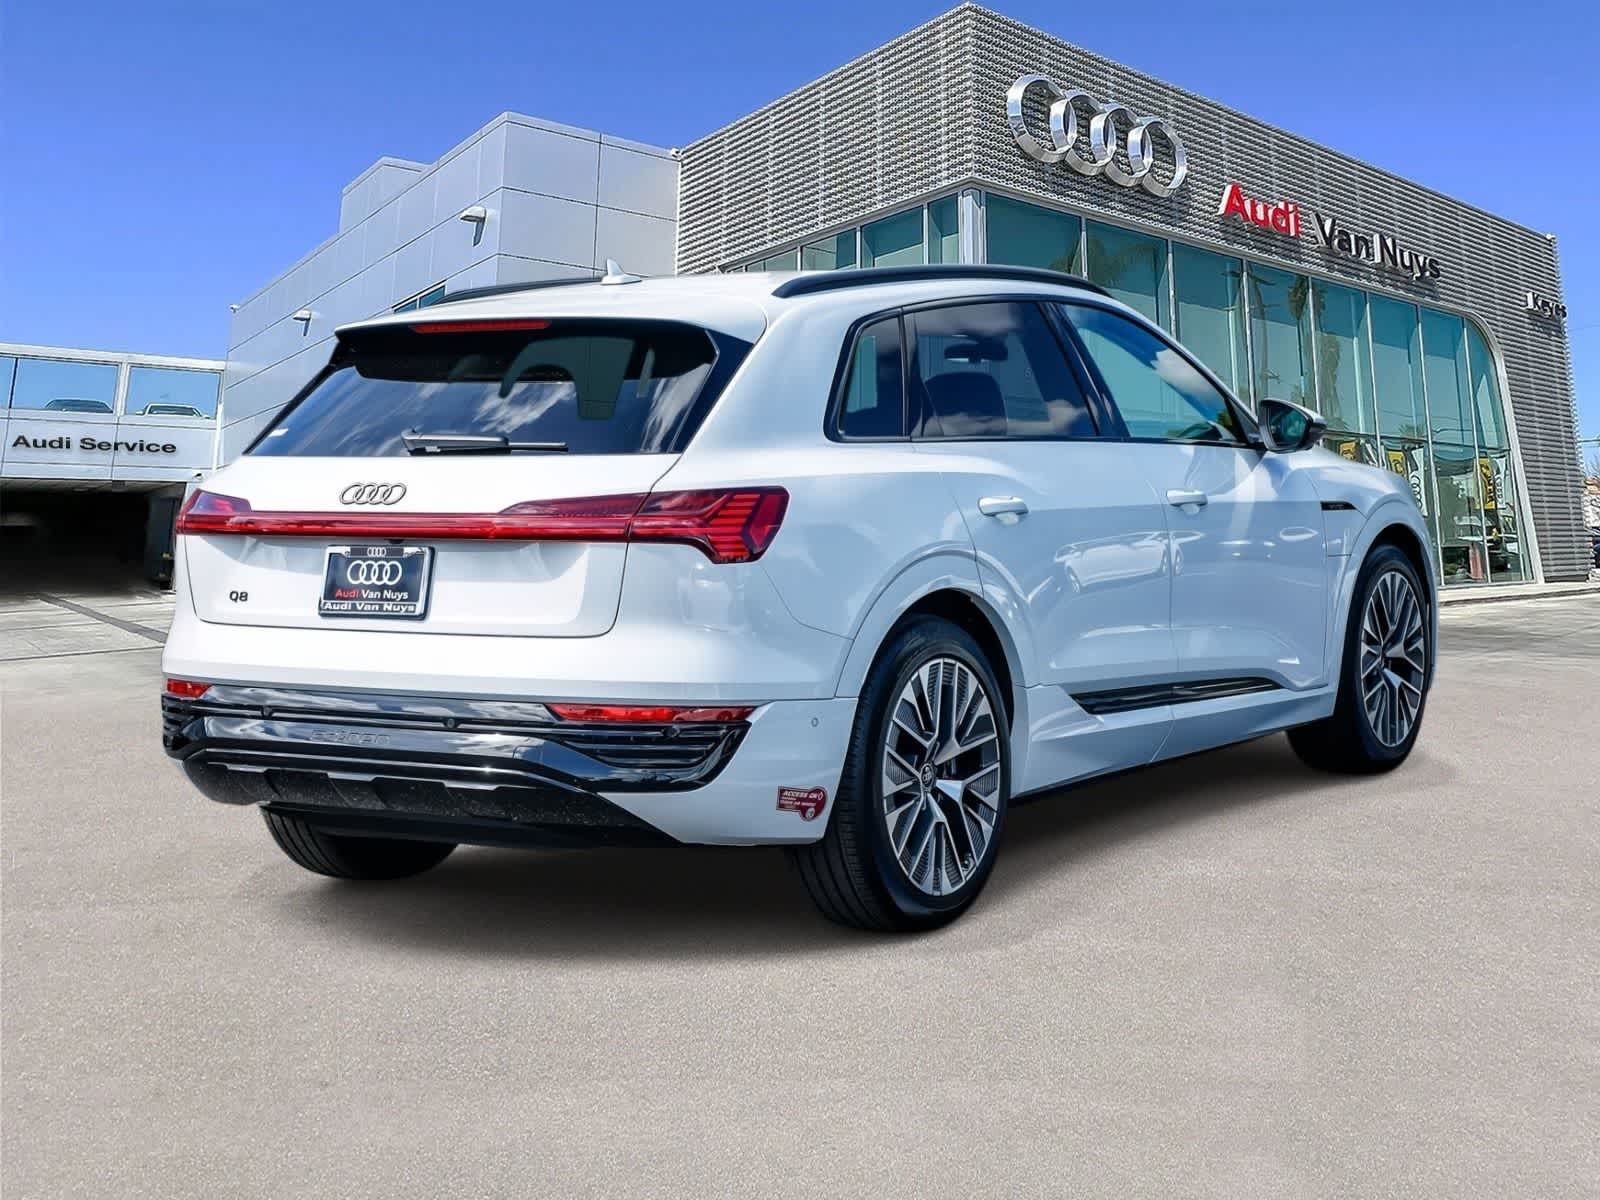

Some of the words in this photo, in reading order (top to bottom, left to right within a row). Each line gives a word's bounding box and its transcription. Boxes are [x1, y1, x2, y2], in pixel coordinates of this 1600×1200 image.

[1218, 183, 1303, 237] Audi
[1310, 212, 1369, 257] Van
[1372, 233, 1442, 280] Nuys
[1526, 292, 1568, 318] Keyes
[12, 435, 72, 450] Audi
[79, 437, 178, 454] Service
[229, 590, 249, 602] Q8
[335, 588, 359, 600] Audi
[361, 589, 381, 600] Van
[383, 590, 409, 601] Nuys
[323, 601, 352, 611] Audi
[356, 602, 382, 612] Van
[383, 602, 416, 613] Nuys
